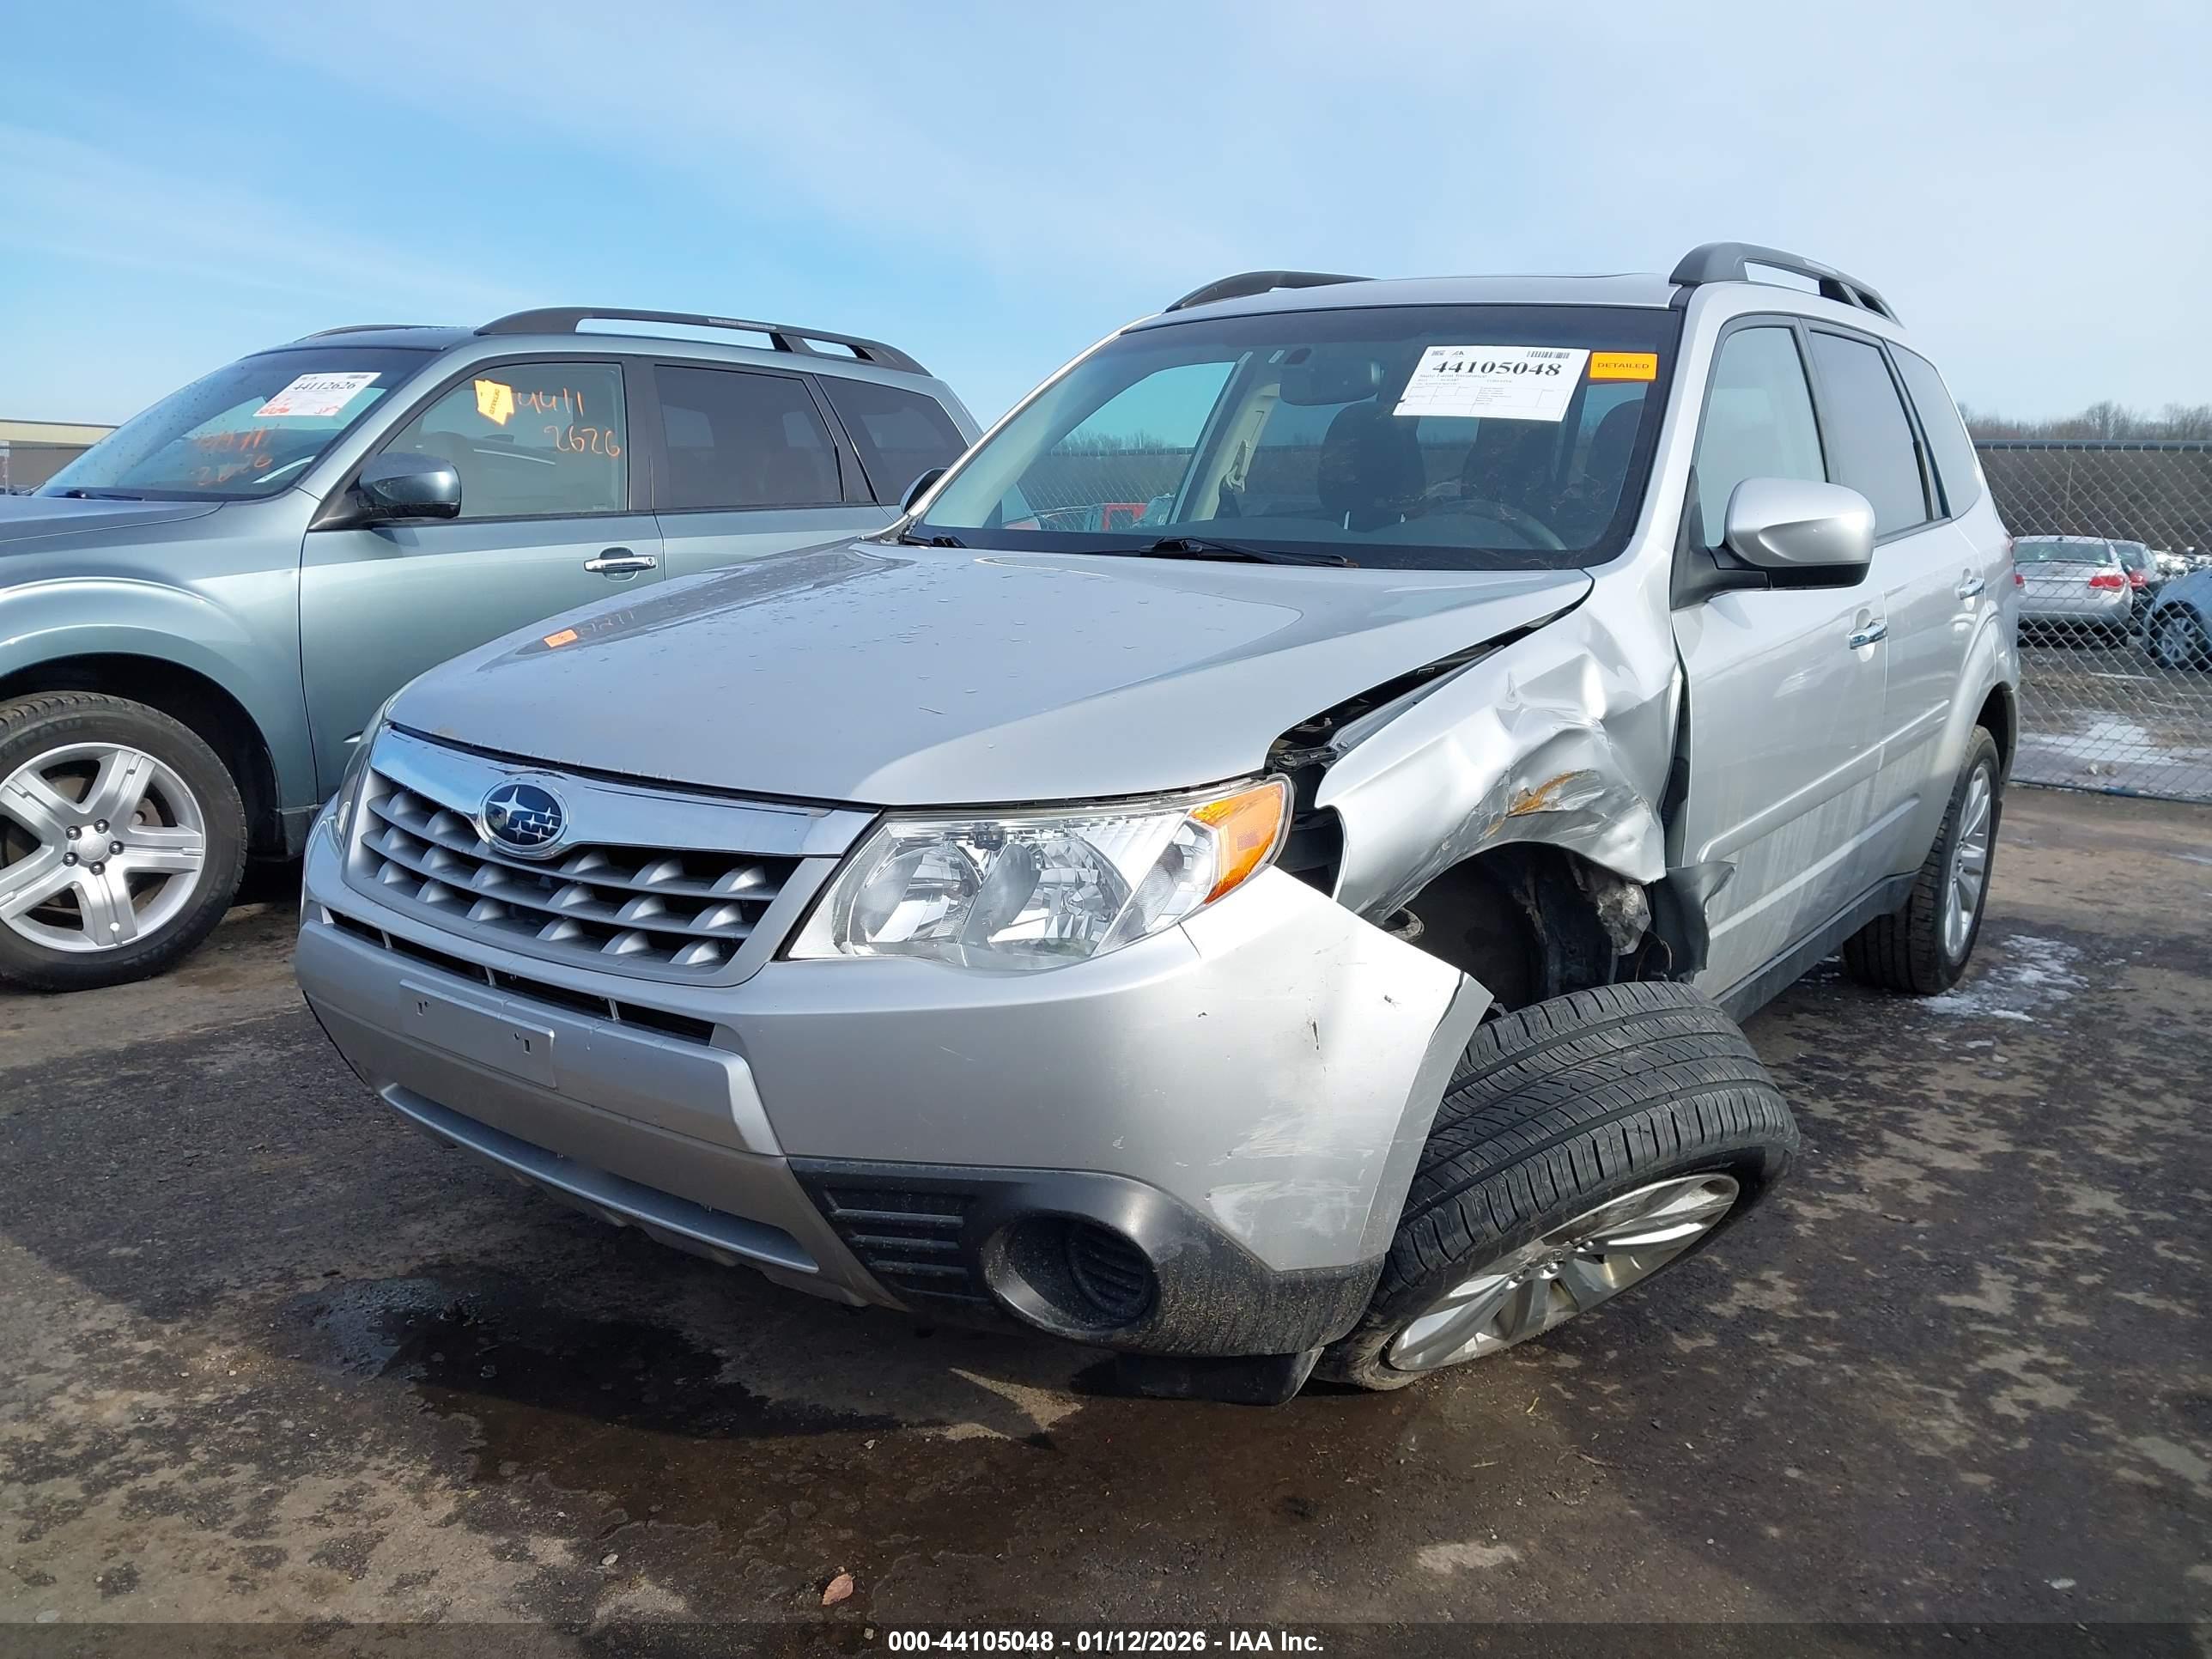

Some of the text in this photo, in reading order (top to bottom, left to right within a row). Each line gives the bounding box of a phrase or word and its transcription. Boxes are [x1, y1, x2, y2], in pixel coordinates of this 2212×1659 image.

[1431, 361, 1561, 376] 44105048
[293, 381, 357, 391] 44112626
[518, 387, 584, 417] 4411
[544, 426, 621, 457] 2626
